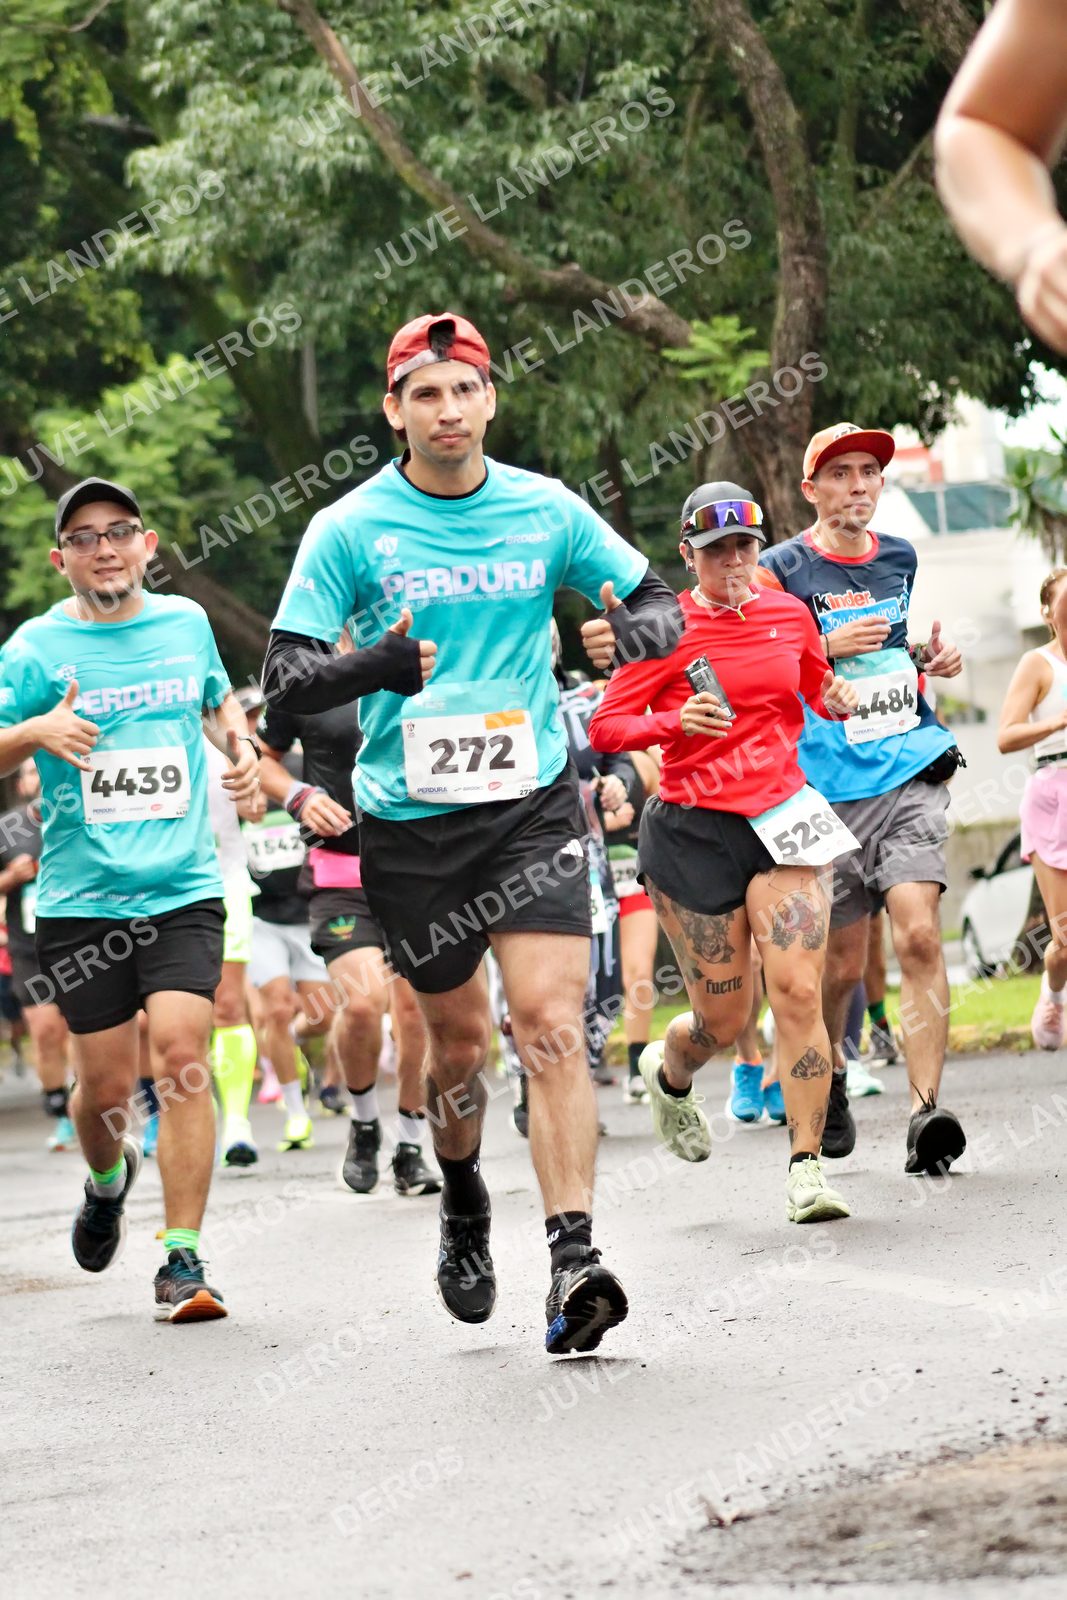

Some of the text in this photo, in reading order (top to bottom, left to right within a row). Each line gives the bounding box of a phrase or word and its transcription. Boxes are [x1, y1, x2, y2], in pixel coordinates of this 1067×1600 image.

[380, 559, 547, 601] PERDURA
[813, 589, 871, 614] Kinder
[428, 734, 515, 774] 272
[91, 764, 182, 798] 4439
